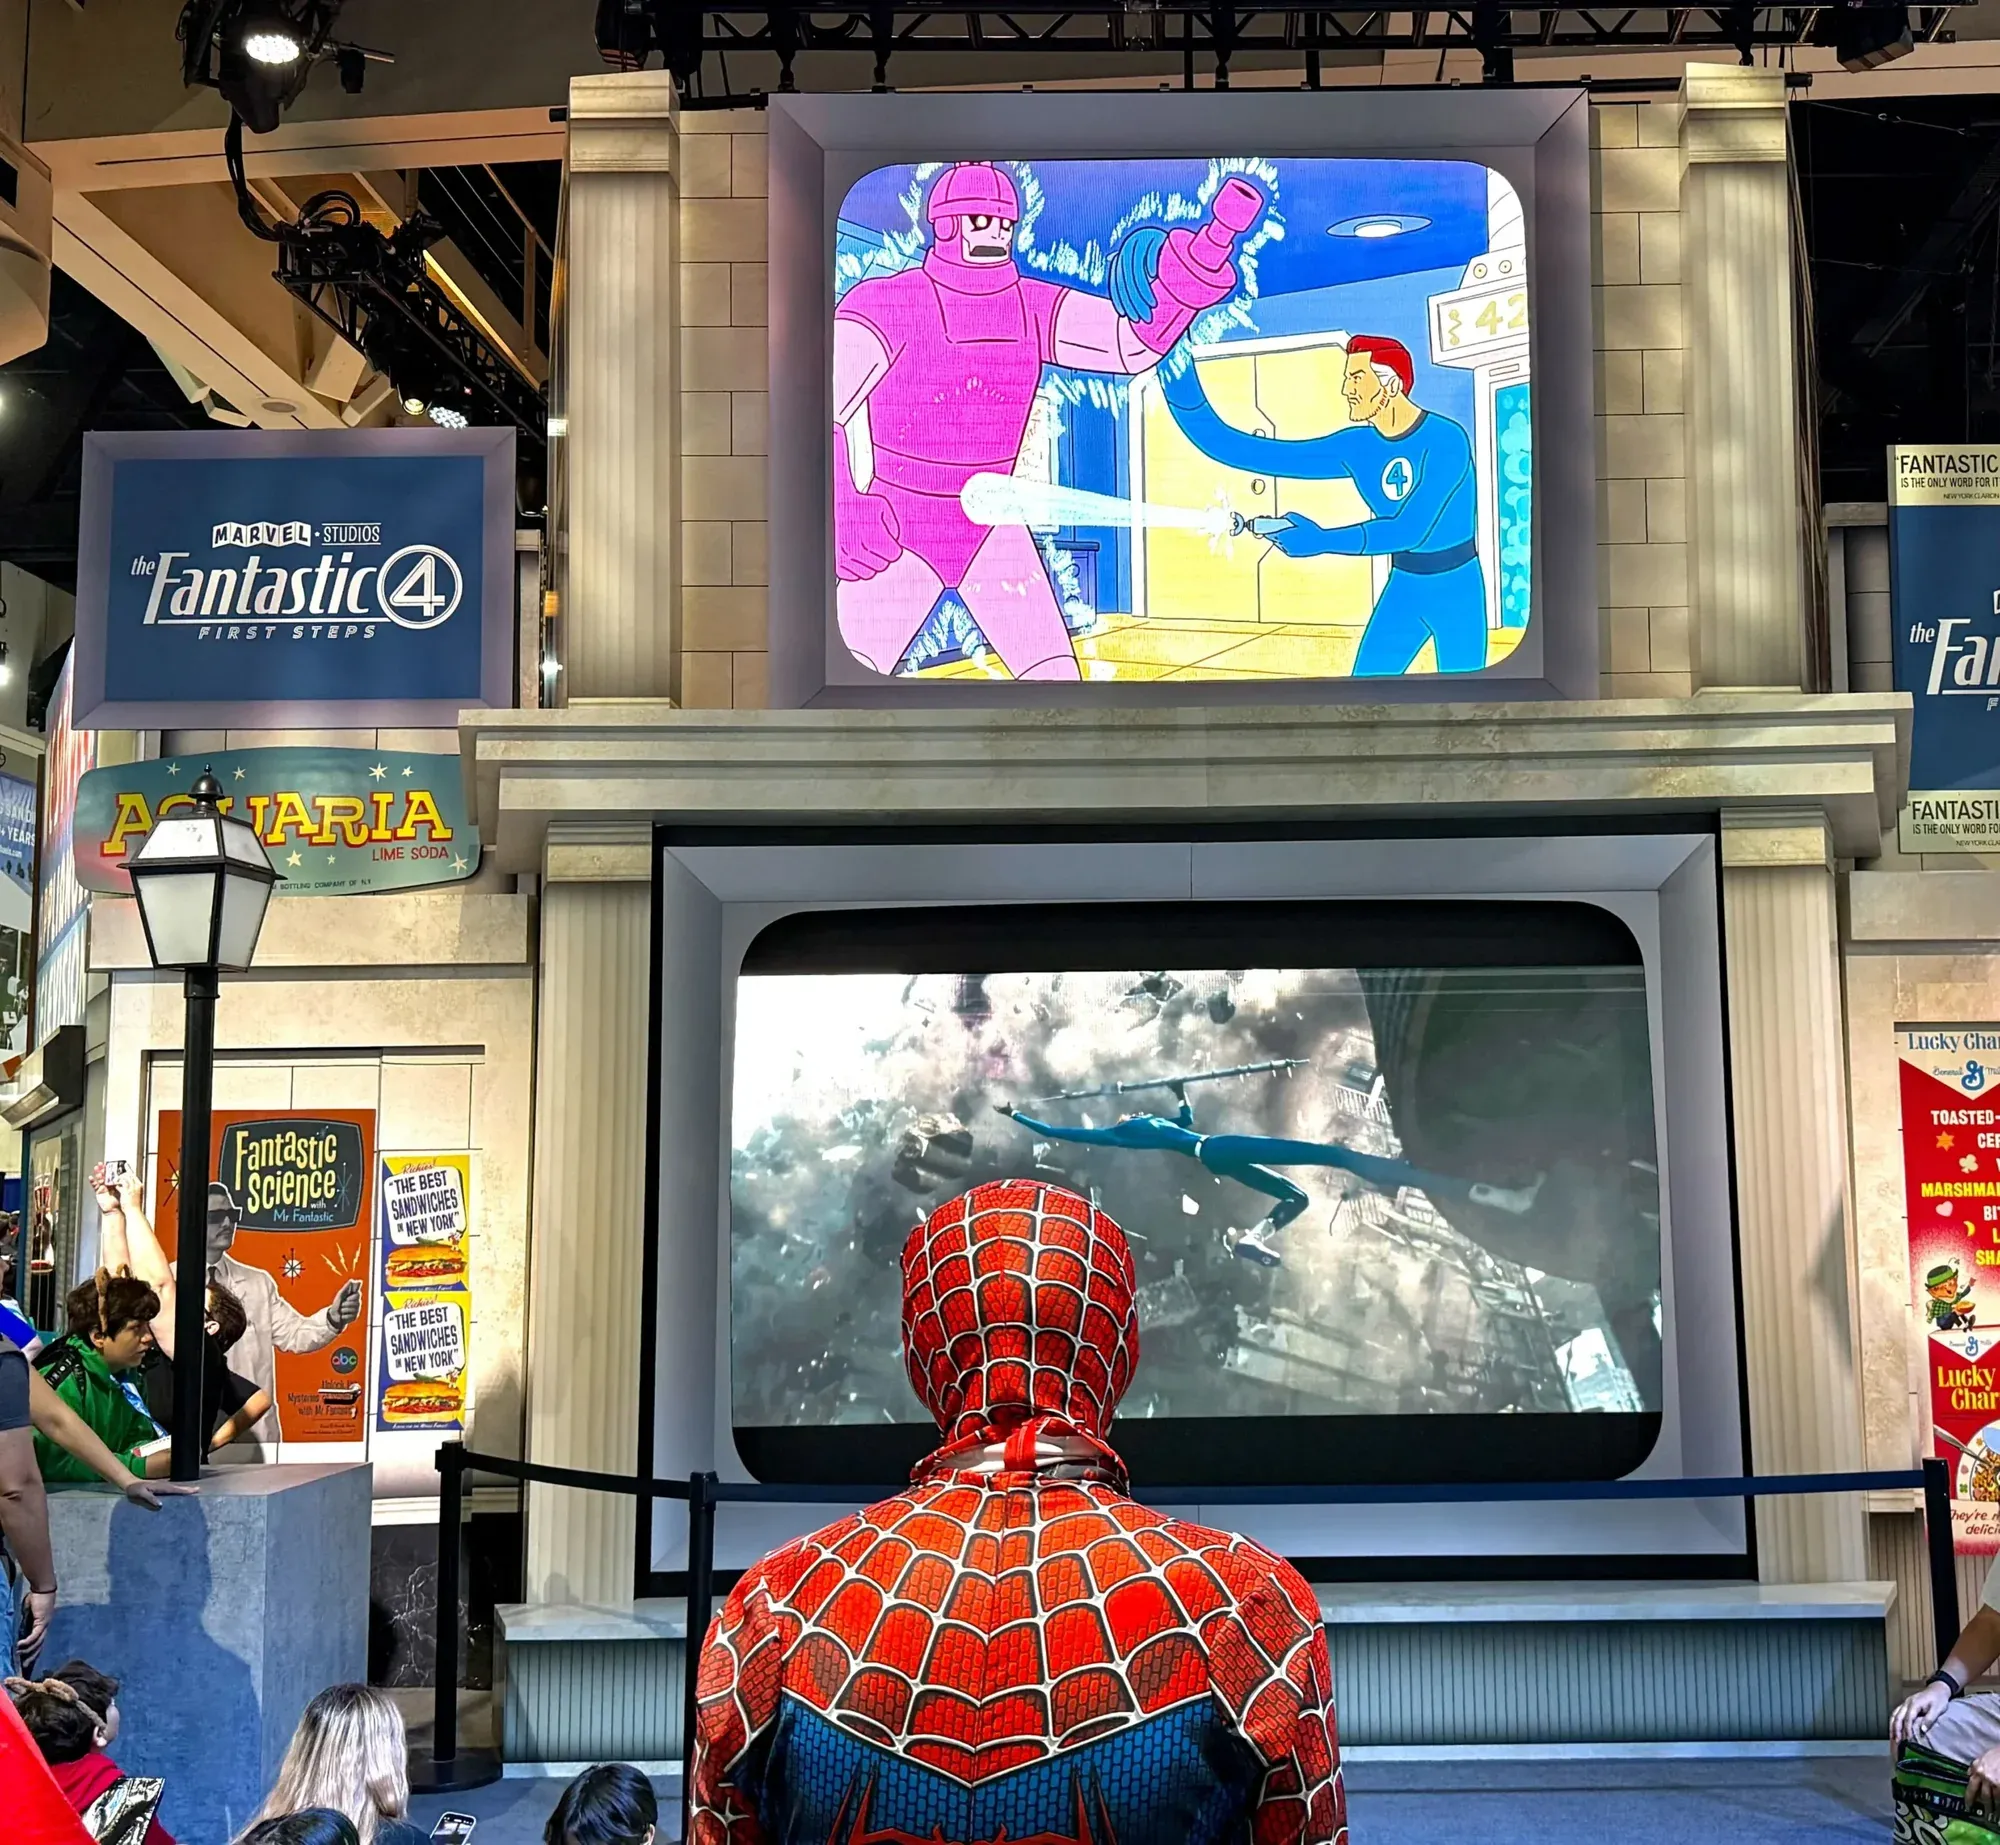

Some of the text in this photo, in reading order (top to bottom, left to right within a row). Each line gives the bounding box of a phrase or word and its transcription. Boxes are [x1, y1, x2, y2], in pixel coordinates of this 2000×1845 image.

[1385, 461, 1409, 498] 4
[1901, 477, 1909, 488] IS
[1911, 477, 1925, 488] THE
[1927, 477, 1948, 488] ONLY
[1950, 477, 1973, 488] WORD
[1975, 477, 1991, 488] FOR
[212, 523, 381, 547] MARVEL STUDIOS
[130, 551, 448, 625] the Fantastic 4
[198, 624, 376, 640] FIRST STEPS
[1909, 622, 1936, 643] the
[1912, 823, 2000, 835] IS THE ONLY WORD FO
[371, 845, 450, 862] LIME SODA
[314, 880, 346, 889] COMPANY
[1908, 1032, 1961, 1054] Lucky
[235, 1130, 337, 1191] Fantastic
[418, 1170, 447, 1191] BEST
[247, 1169, 336, 1214] Science
[310, 1197, 327, 1209] with
[391, 1188, 458, 1221] SANDWICHES
[273, 1208, 334, 1222] Mr Fantastic
[405, 1218, 428, 1237] NEW
[419, 1306, 449, 1326] BEST
[390, 1324, 459, 1356] SANDWICHES
[332, 1353, 357, 1365] abc
[403, 1353, 426, 1373] NEW
[1937, 1364, 1996, 1391] Lucky
